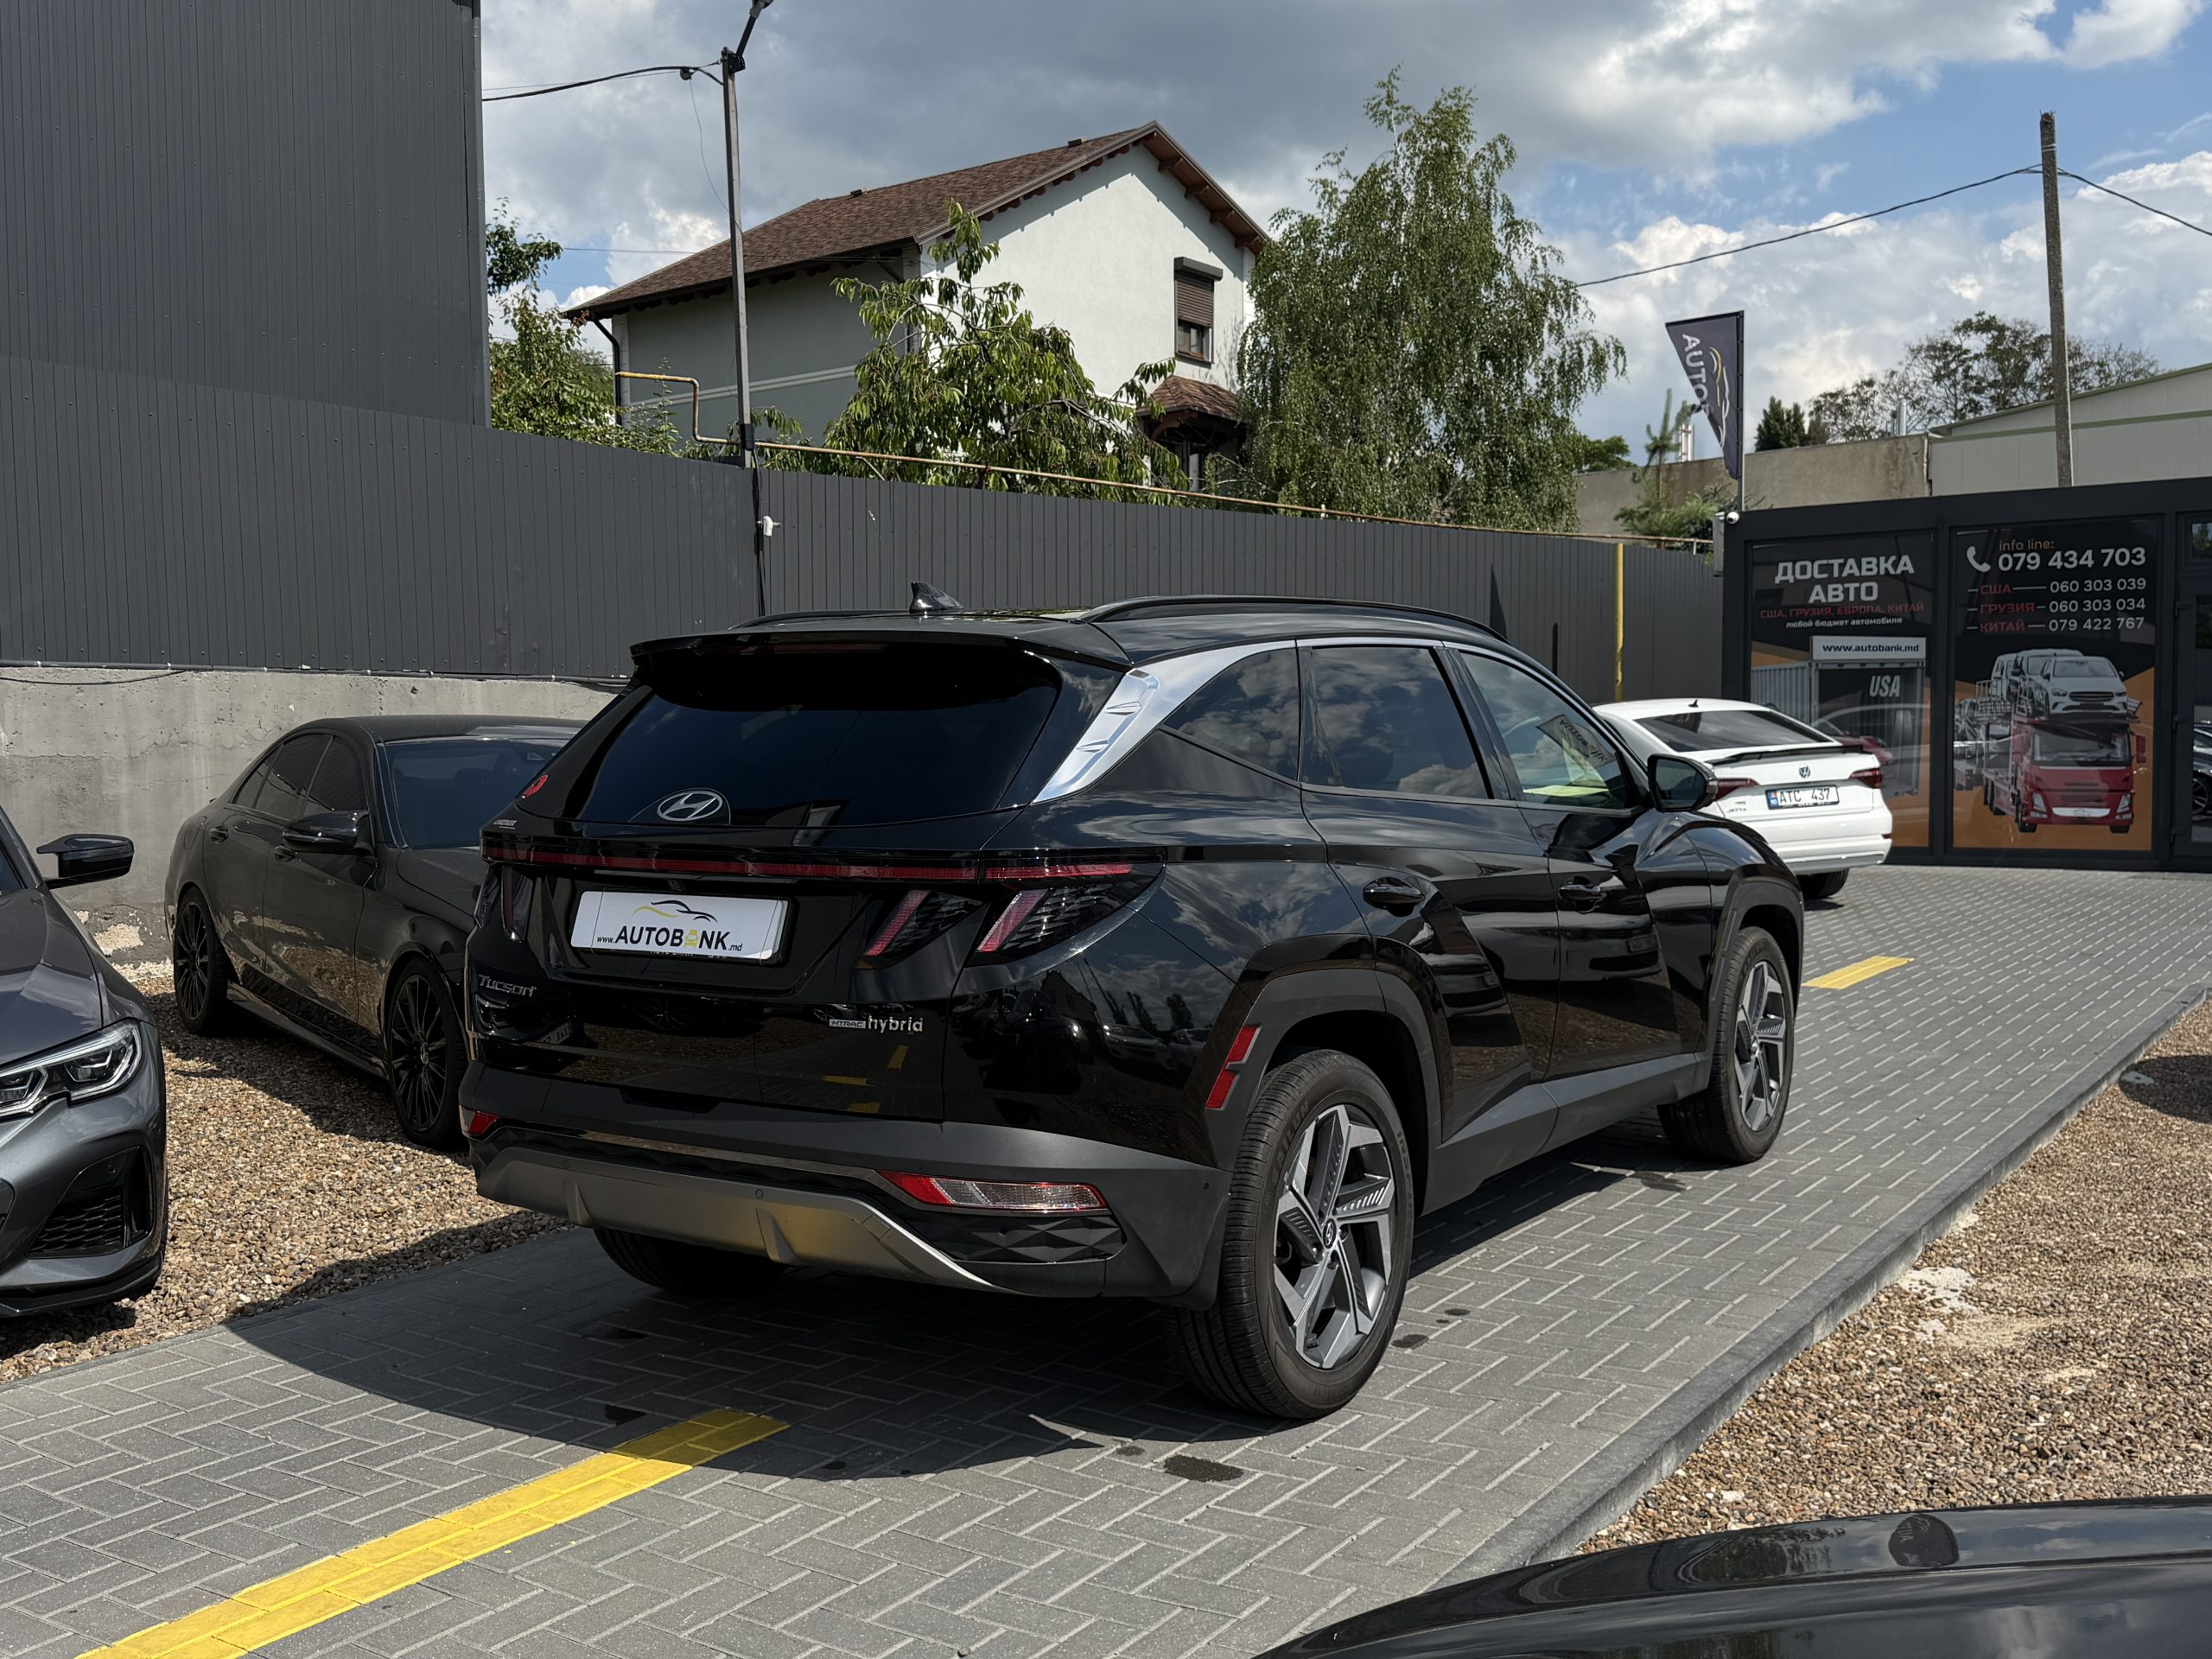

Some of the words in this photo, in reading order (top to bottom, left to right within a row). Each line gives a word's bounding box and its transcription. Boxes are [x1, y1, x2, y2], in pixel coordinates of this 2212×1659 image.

[1999, 539, 2024, 551] info
[2027, 538, 2054, 550] line:
[1998, 551, 2041, 572] 079
[2047, 550, 2094, 569] 434
[2101, 547, 2146, 568] 703
[1774, 555, 1915, 584] ДОСТАВКА
[1808, 581, 1878, 604] АВТО
[1980, 583, 2012, 595] США
[2050, 580, 2080, 594] 060
[2083, 579, 2113, 592] 303
[2117, 577, 2146, 591] 039
[1887, 601, 1925, 613] КИТАЙ
[1980, 602, 2035, 614] ГРУЗИЯ
[2049, 600, 2079, 613] 060
[2082, 599, 2112, 612] 303
[2116, 597, 2145, 611] 034
[1786, 618, 1813, 629] любой
[1815, 618, 1849, 629] бюджет
[1850, 616, 1903, 627] автомобиля
[1980, 619, 2025, 632] КИТАЙ
[2048, 619, 2078, 632] 079
[2082, 618, 2112, 631] 422
[2116, 617, 2145, 630] 767
[1822, 643, 1919, 653] www.autobank.md
[1868, 674, 1901, 698] USA
[1779, 790, 1802, 804] ATC
[1811, 787, 1830, 801] 437
[868, 1014, 924, 1033] hybrid
